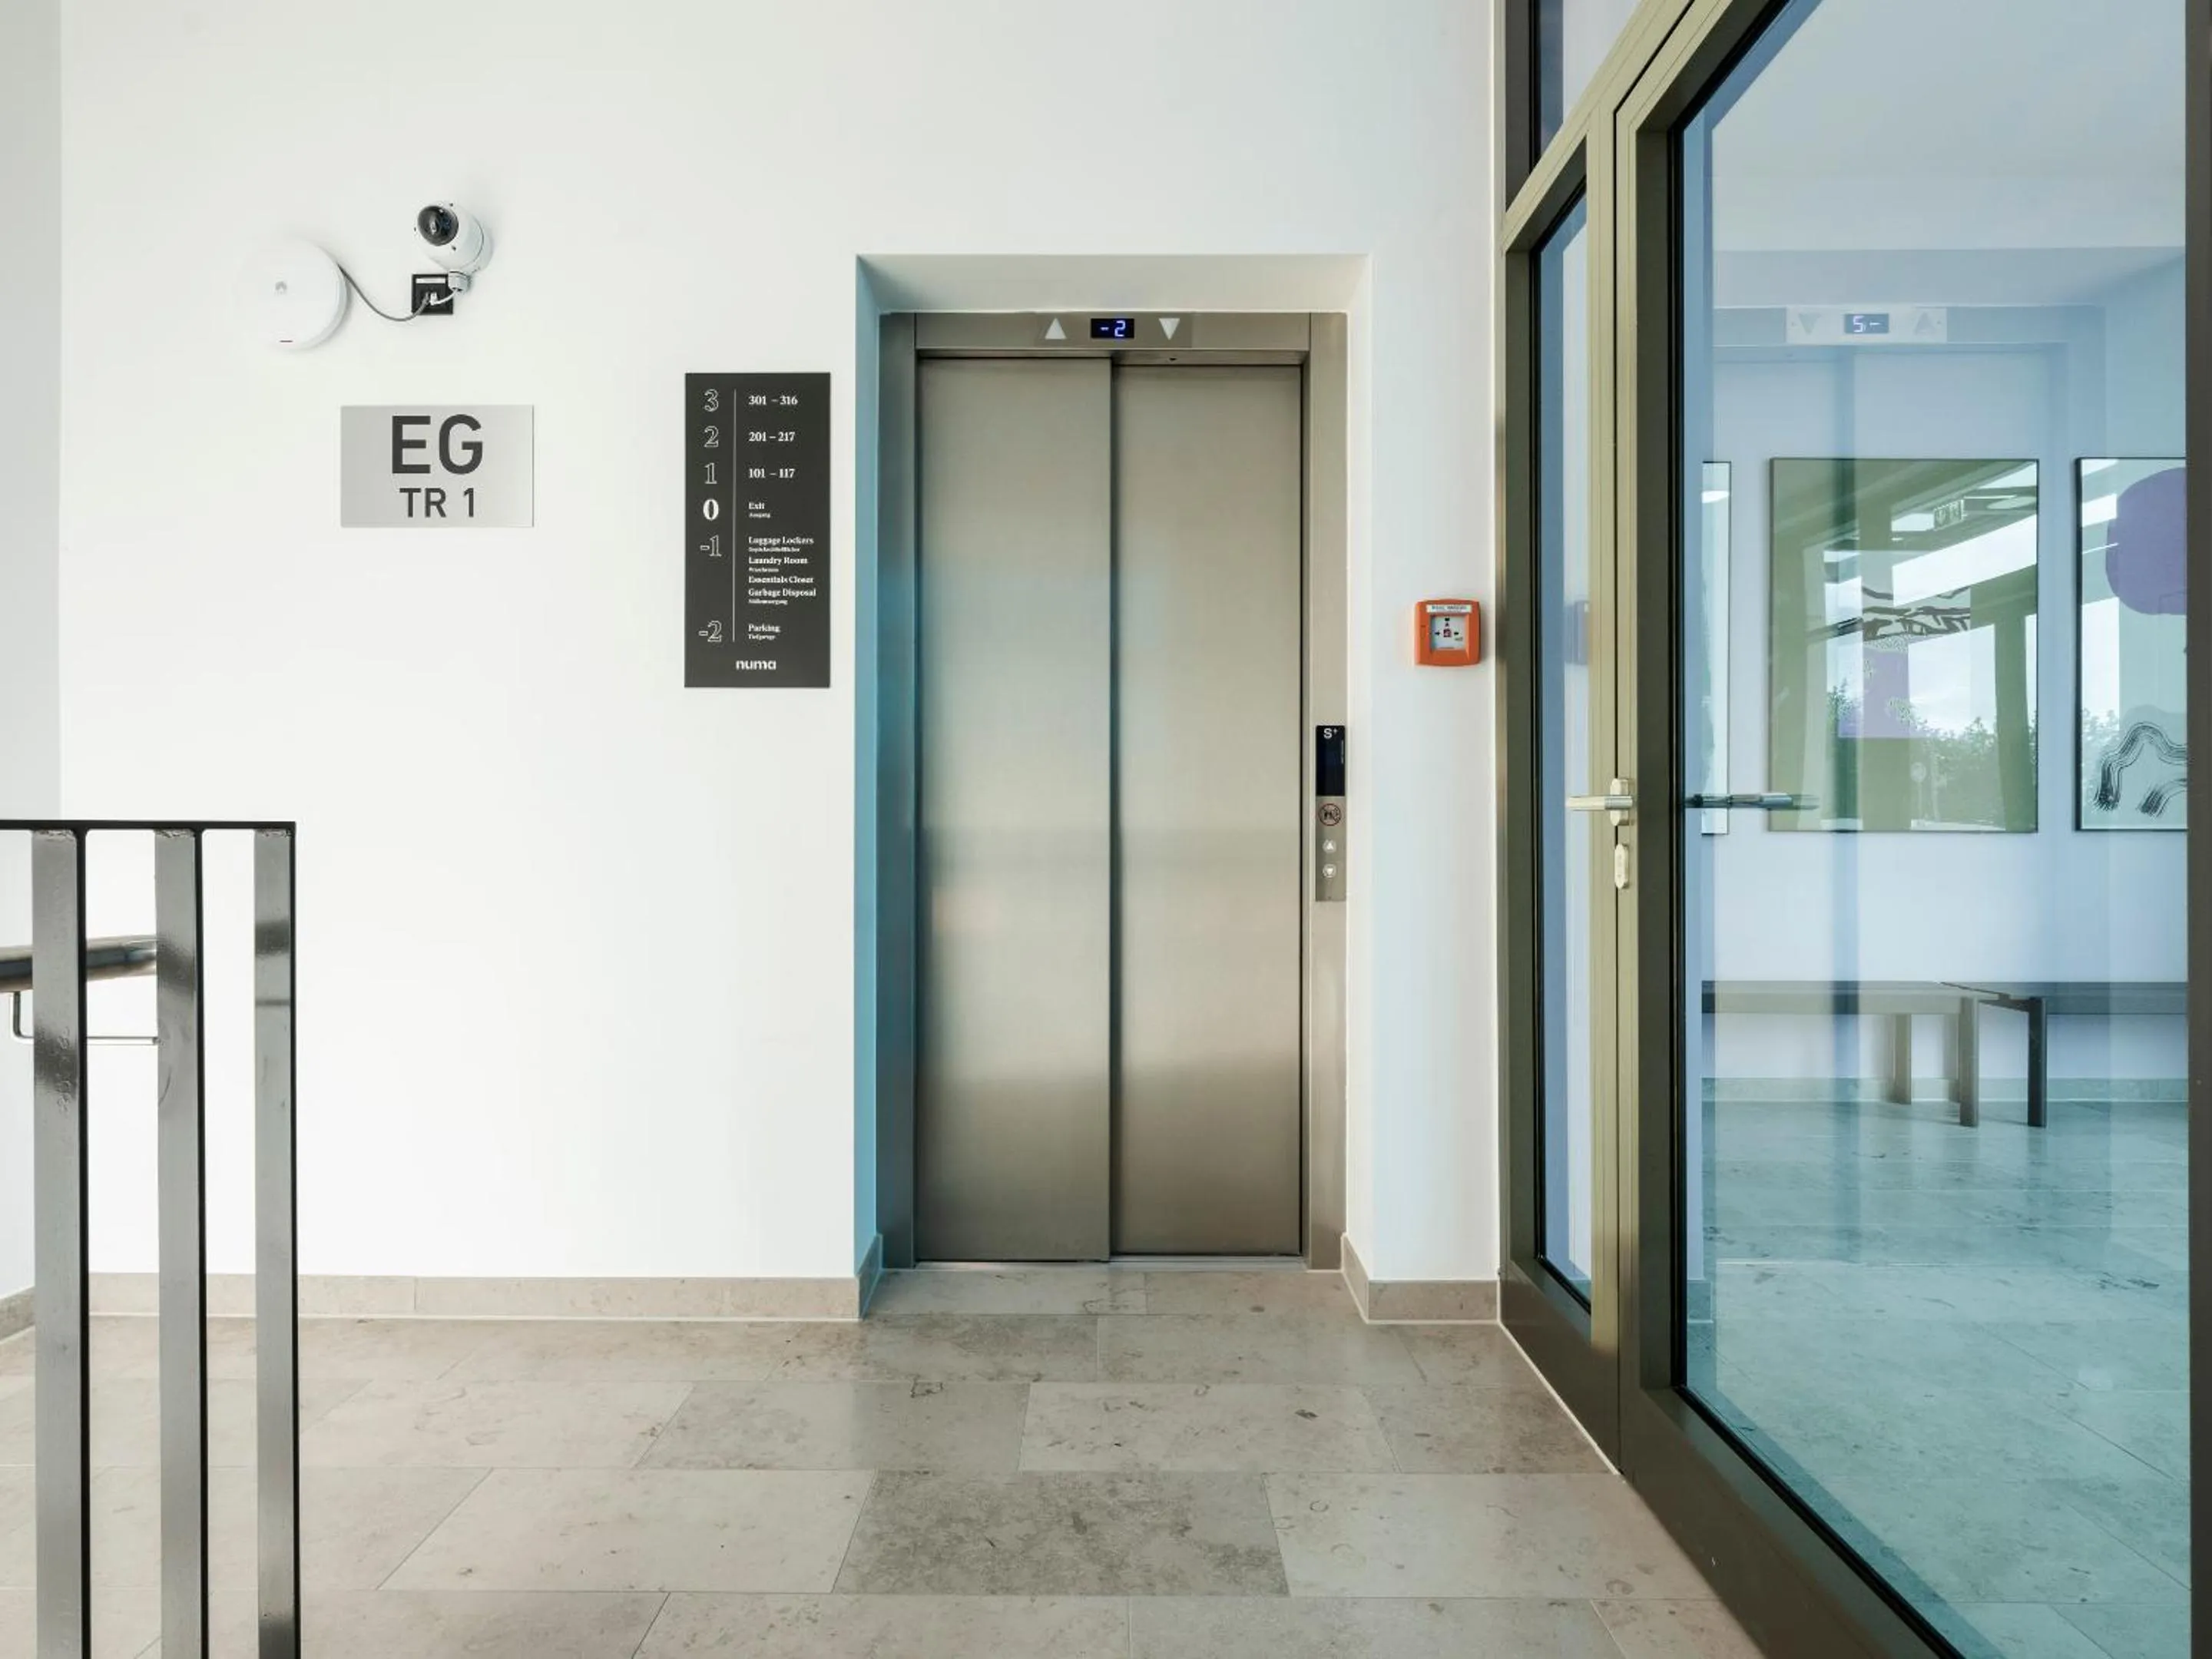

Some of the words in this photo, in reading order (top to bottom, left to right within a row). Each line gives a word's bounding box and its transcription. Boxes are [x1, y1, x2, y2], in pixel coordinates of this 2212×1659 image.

[1100, 320, 1126, 337] -2
[704, 389, 719, 412] 3
[748, 395, 767, 406] 301
[780, 395, 799, 406] 316
[704, 426, 719, 448] 2
[748, 432, 767, 442] 201
[777, 431, 796, 442] 217
[392, 414, 483, 475] EG
[704, 462, 717, 485] 1
[748, 468, 766, 478] 101
[778, 468, 796, 478] 117
[399, 488, 446, 518] TR
[463, 488, 474, 518] 1
[748, 502, 765, 510] Exit
[703, 498, 720, 522] 0
[700, 535, 722, 557] -1
[748, 536, 780, 545] Luggage
[782, 536, 814, 545] Lockers
[748, 556, 782, 565] Laundry
[783, 556, 808, 565] Room
[748, 575, 788, 584] Essentials
[789, 575, 814, 584] Closet
[748, 588, 781, 598] Garbage
[782, 588, 816, 598] Disposal
[698, 620, 722, 642] -2
[748, 623, 781, 633] Parking
[736, 660, 777, 671] numa
